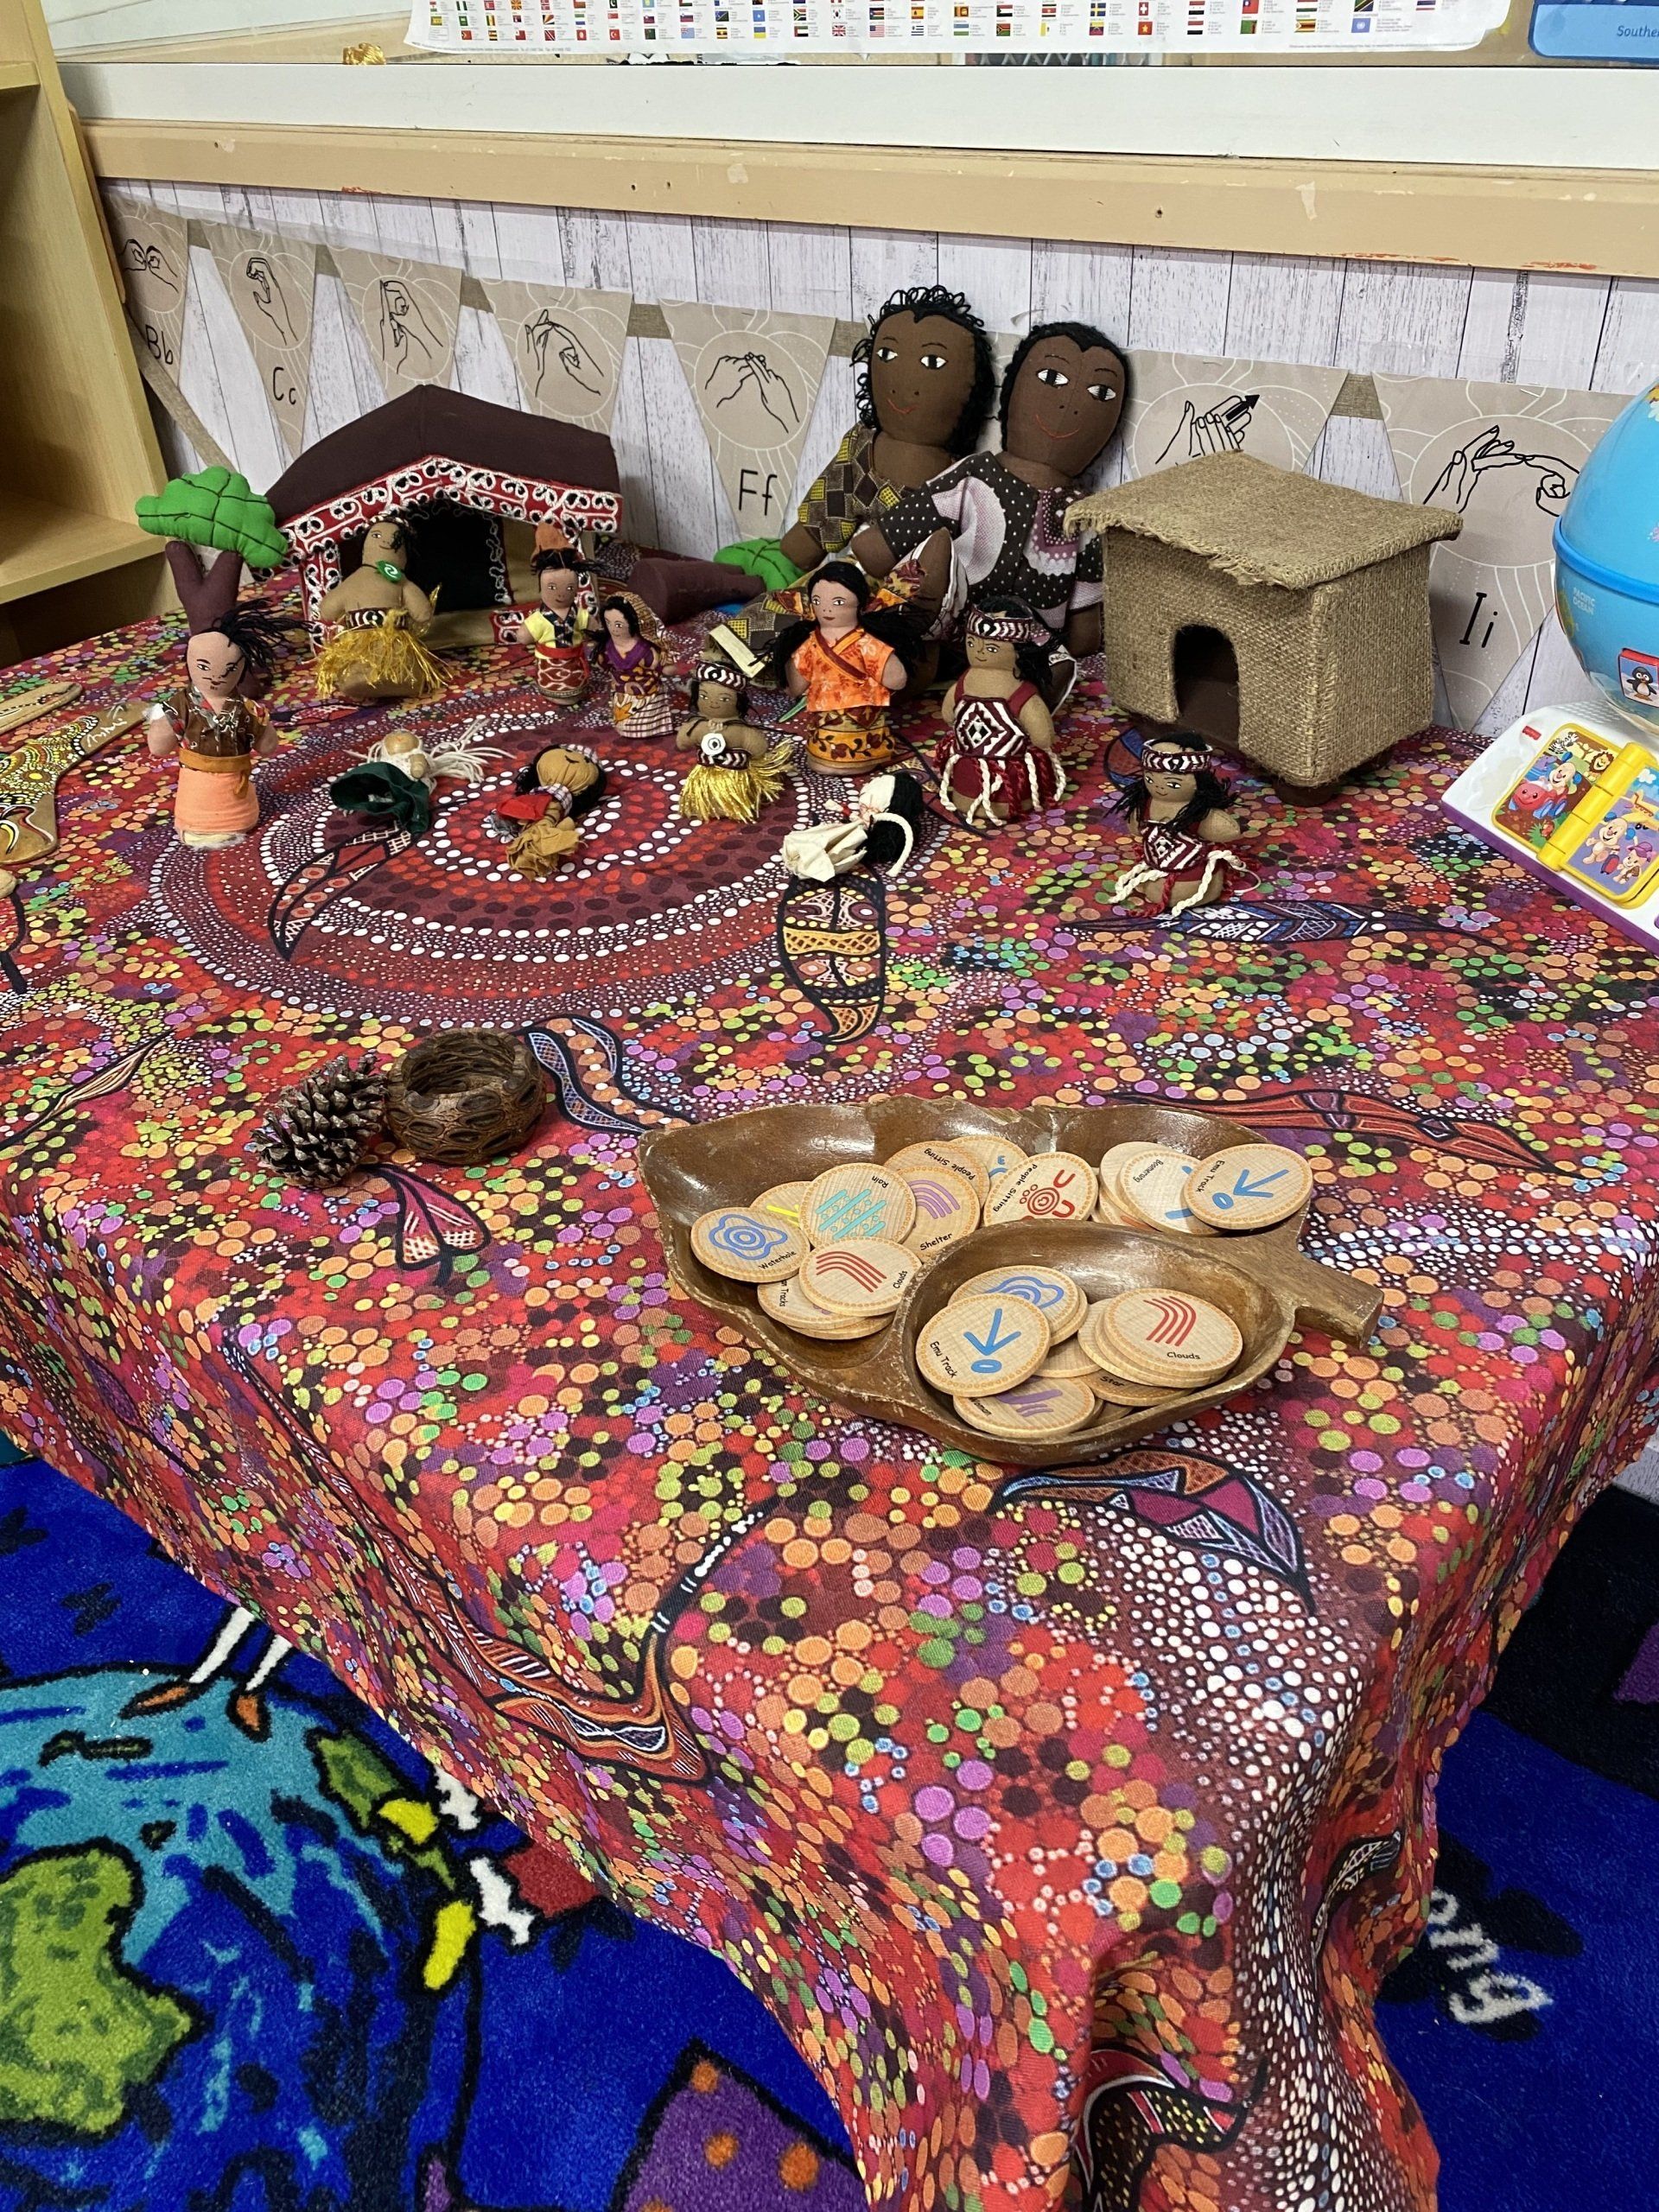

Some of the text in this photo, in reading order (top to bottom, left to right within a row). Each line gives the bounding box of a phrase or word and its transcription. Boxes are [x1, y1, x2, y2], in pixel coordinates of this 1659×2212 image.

[1617, 24, 1659, 37] Southe
[145, 325, 174, 365] Bb
[272, 366, 296, 405] Cc
[738, 469, 778, 516] Ff
[1459, 592, 1497, 648] Ii
[924, 1147, 976, 1180] People Sitting
[1132, 1159, 1164, 1183] Boomerang
[871, 1175, 889, 1188] Rain
[992, 1163, 1038, 1212] People Sitting
[1196, 1160, 1225, 1192] Emu Track
[919, 1232, 952, 1251] Shelter
[758, 1249, 797, 1269] Waterhole
[893, 1269, 908, 1289] Clouds
[779, 1288, 789, 1307] Tracks
[930, 1341, 957, 1378] Emu Track
[1166, 1351, 1201, 1361] Clouds
[1099, 1376, 1125, 1387] Star
